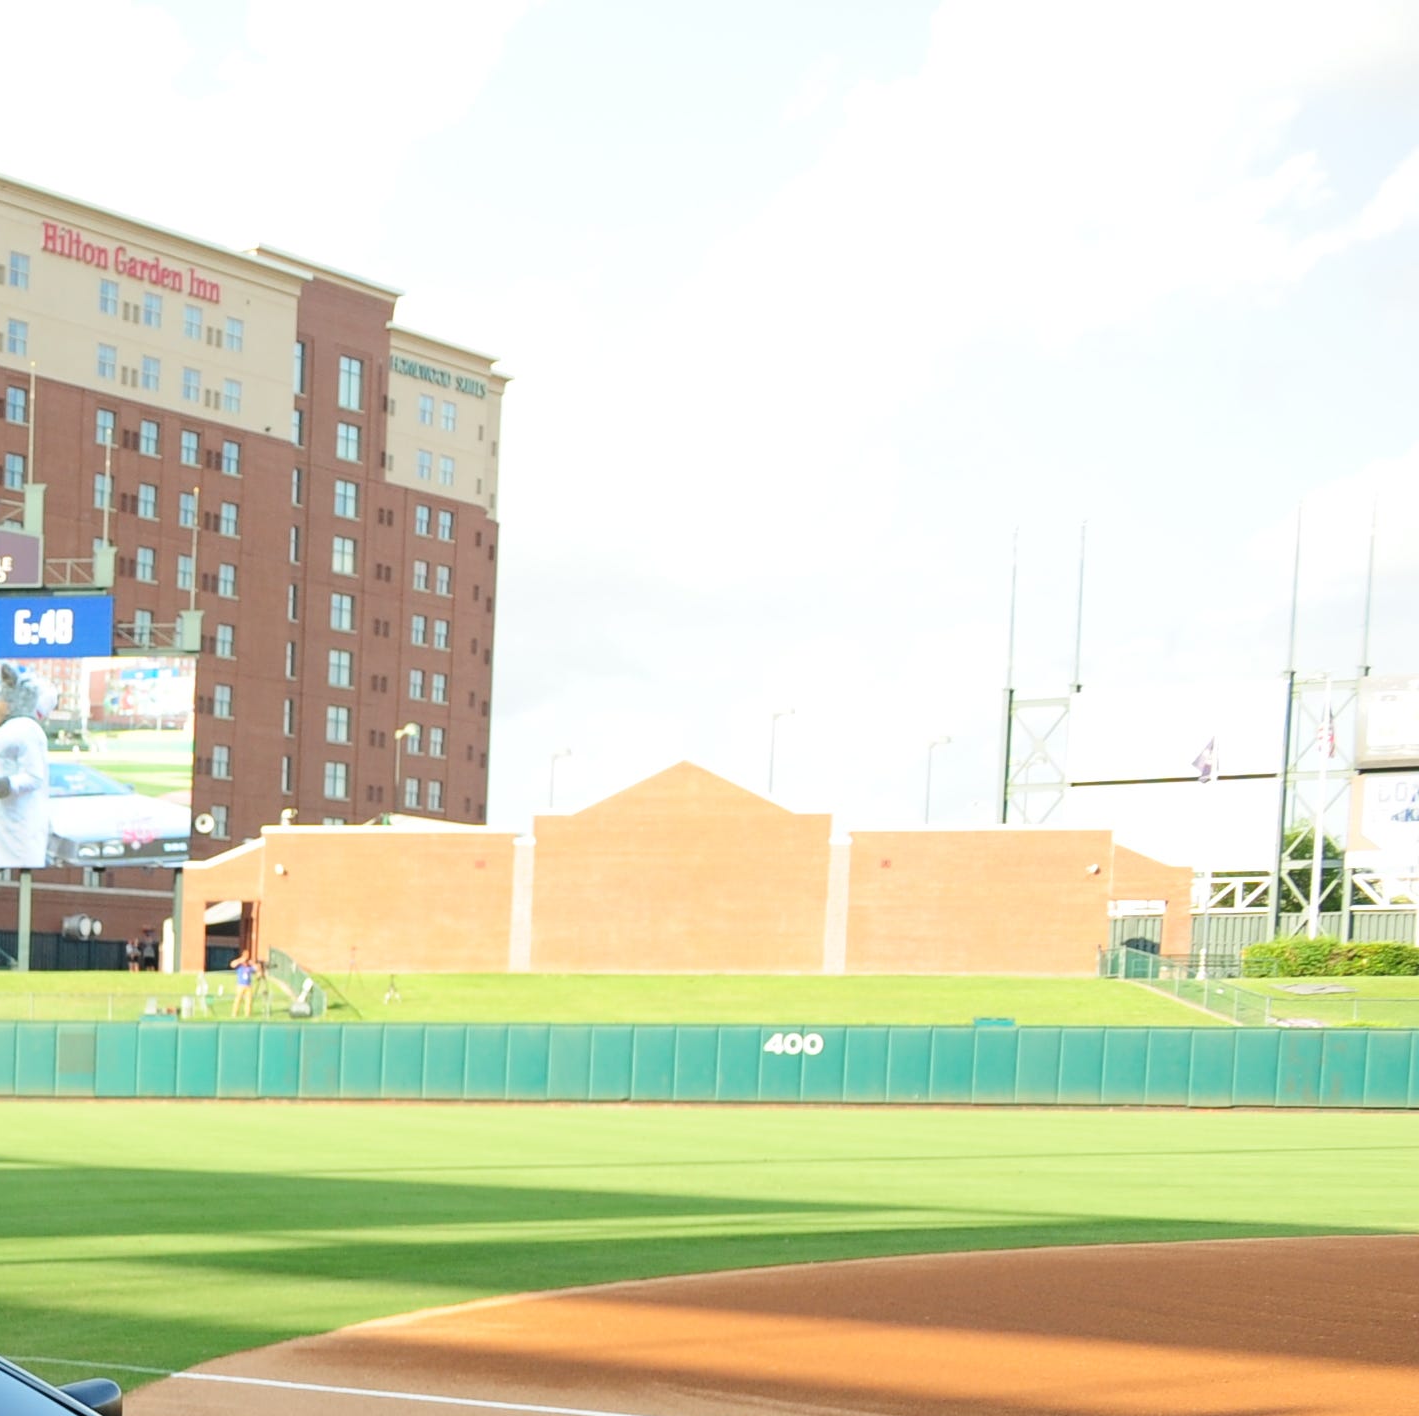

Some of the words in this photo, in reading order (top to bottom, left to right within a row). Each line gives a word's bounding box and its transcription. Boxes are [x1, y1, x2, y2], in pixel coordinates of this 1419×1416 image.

[42, 220, 109, 271] Hilton
[114, 246, 183, 293] Garden
[188, 268, 221, 304] Inn
[763, 1032, 824, 1055] 400
